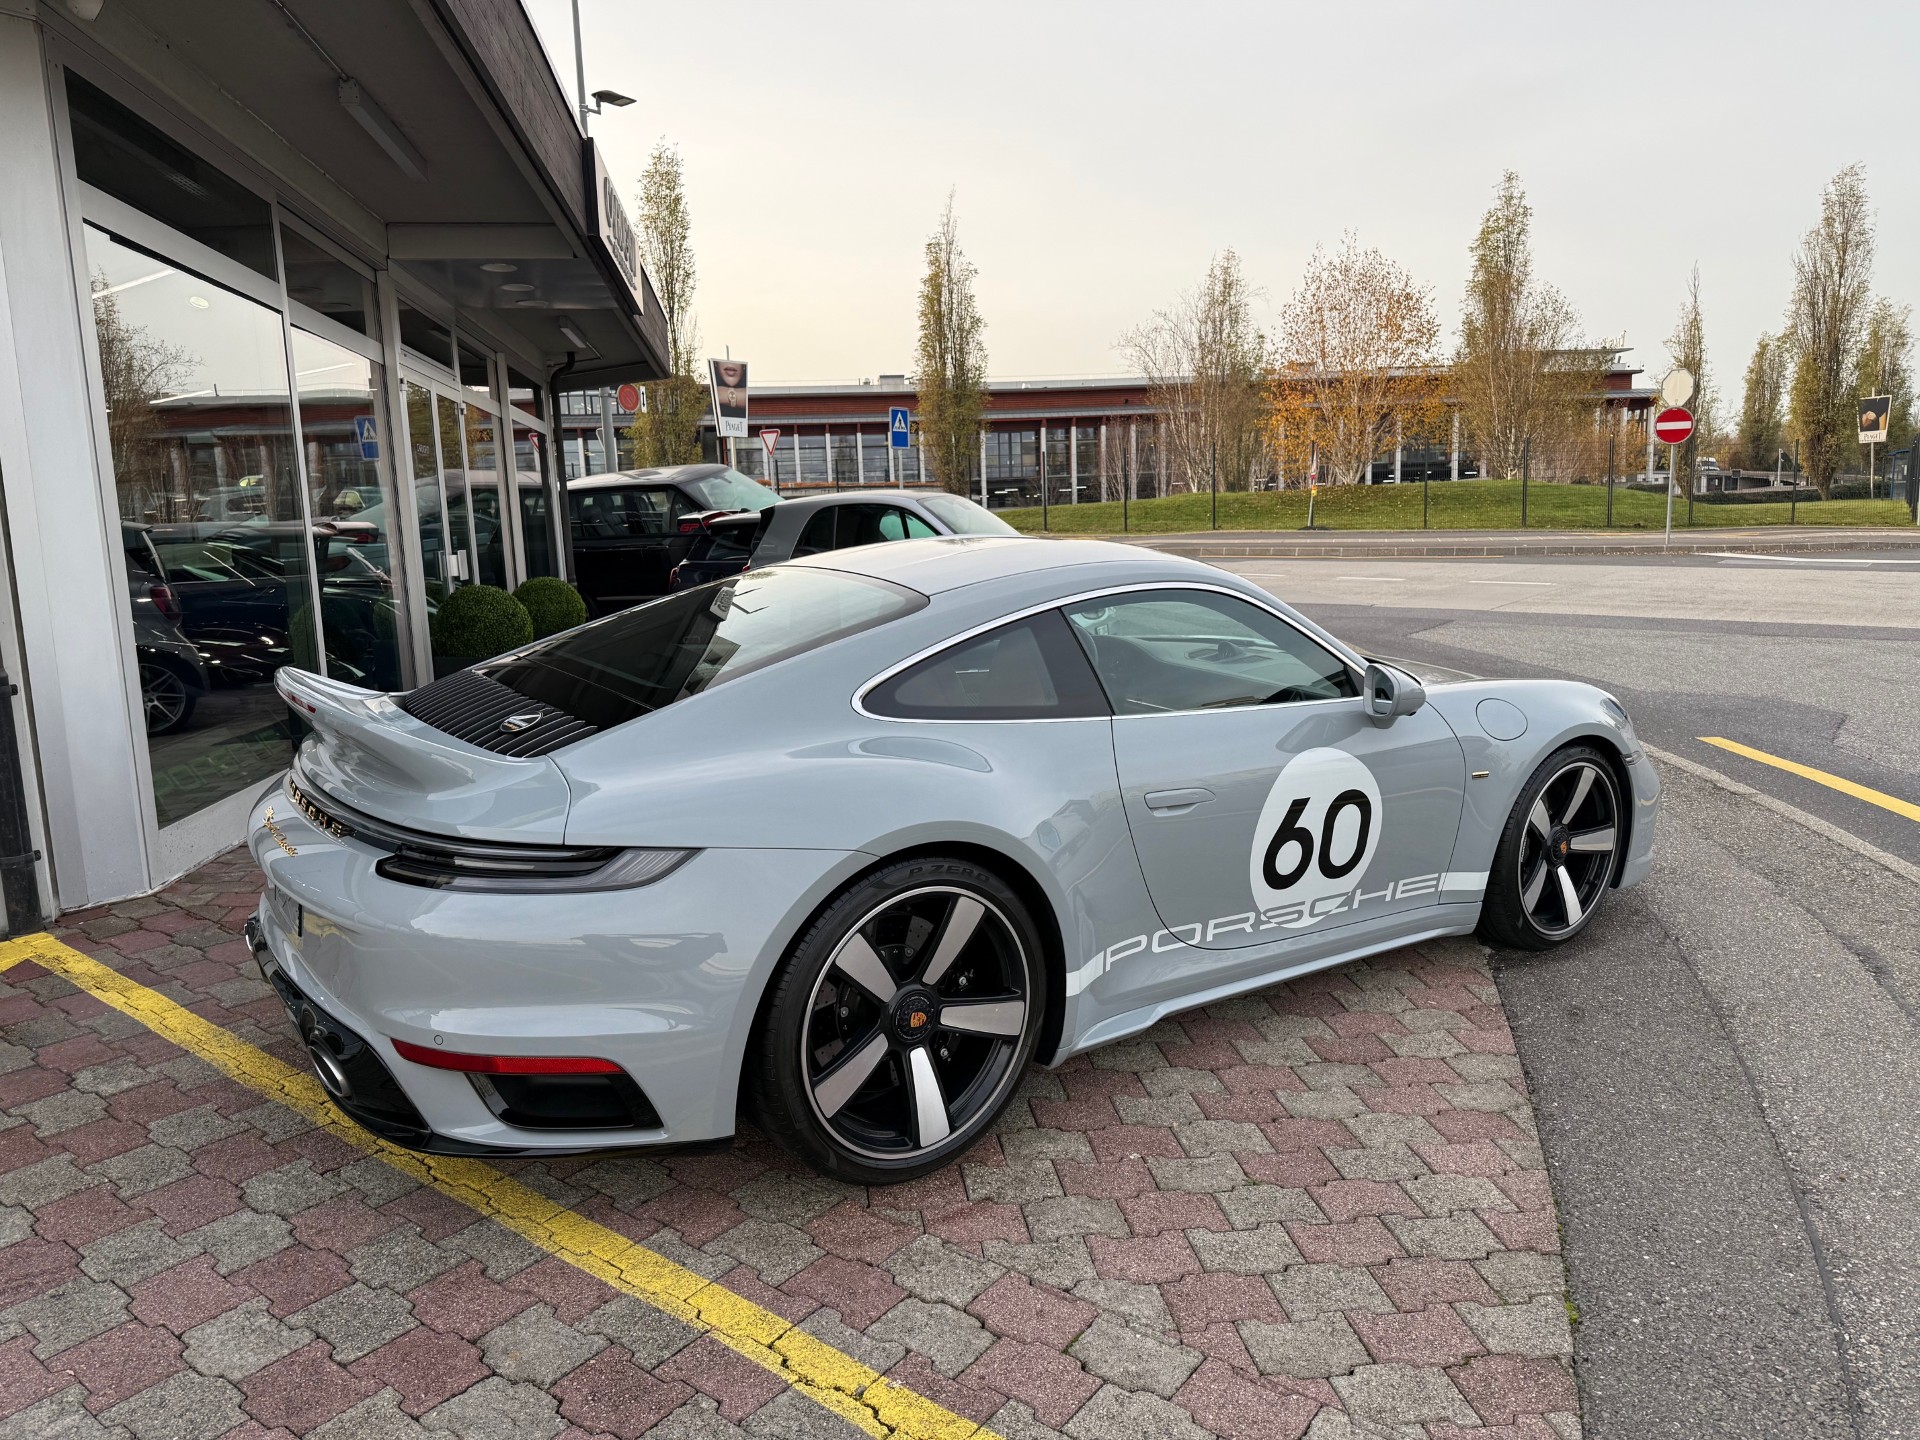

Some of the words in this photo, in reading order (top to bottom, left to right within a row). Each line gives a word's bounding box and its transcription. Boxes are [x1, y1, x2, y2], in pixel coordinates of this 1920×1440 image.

[725, 421, 743, 432] PIAGET
[1262, 788, 1373, 891] 60
[908, 866, 924, 879] P
[928, 864, 992, 882] ZERO
[1104, 872, 1440, 972] PORSCHE
